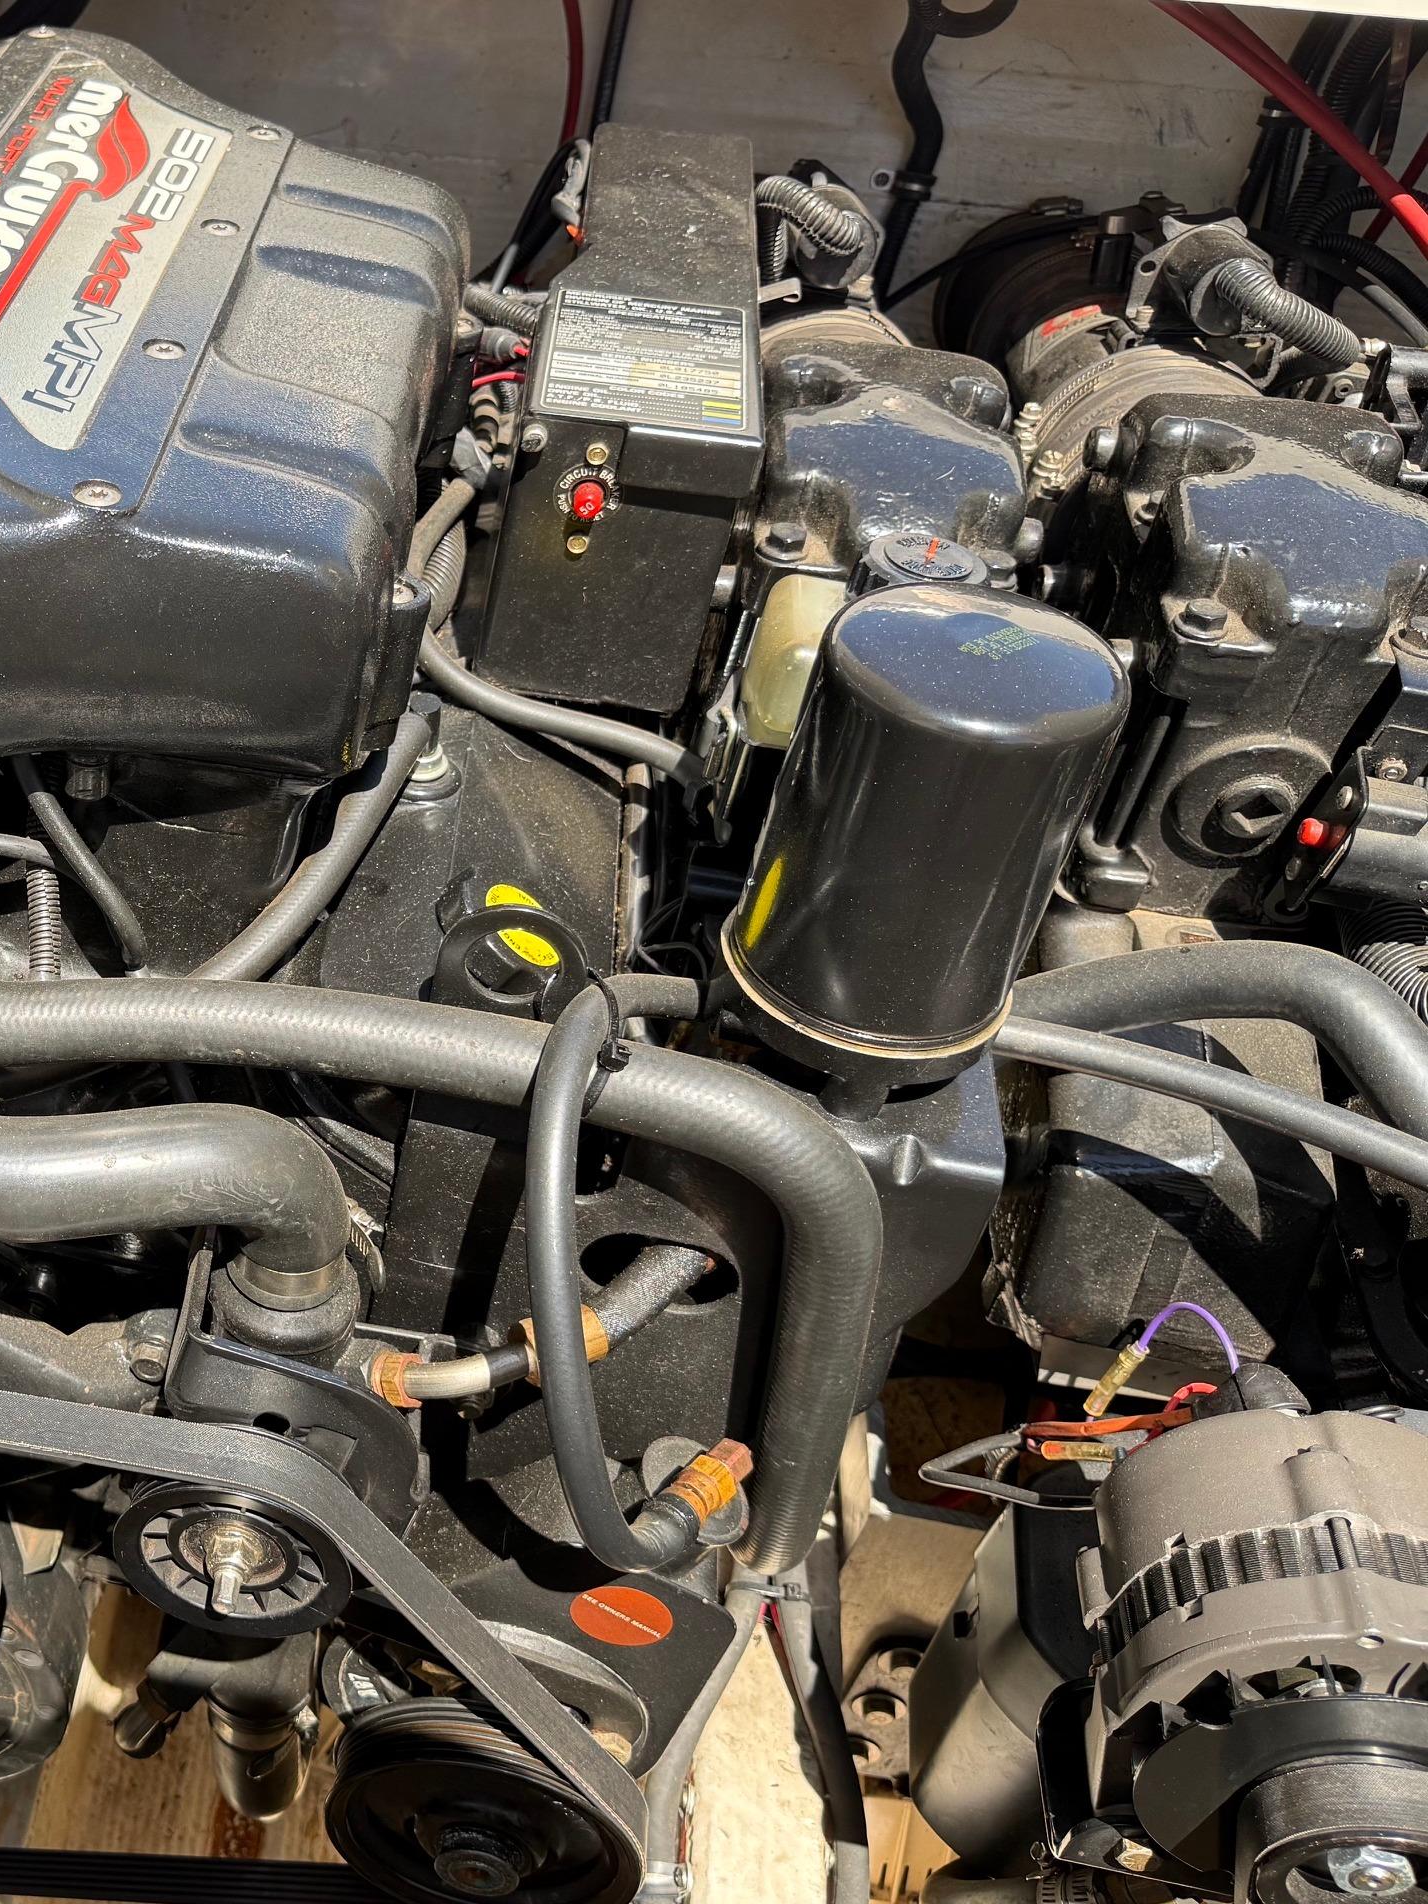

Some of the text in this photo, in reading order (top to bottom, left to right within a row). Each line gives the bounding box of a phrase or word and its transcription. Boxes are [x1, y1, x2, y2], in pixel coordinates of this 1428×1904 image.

[29, 76, 75, 122] MULTI
[27, 127, 215, 413] 502 MAG MPI
[680, 306, 722, 315] MARINE
[547, 388, 579, 396] DRIVE
[548, 383, 590, 392] ENGINE
[608, 385, 685, 398] COLOR CODES
[545, 397, 588, 406] ENGINE
[559, 468, 620, 510] CIRCUIT BREAKER
[557, 494, 571, 514] PUSH
[579, 502, 595, 515] 50
[581, 1593, 662, 1639] SEE OWNERS MANUAL
